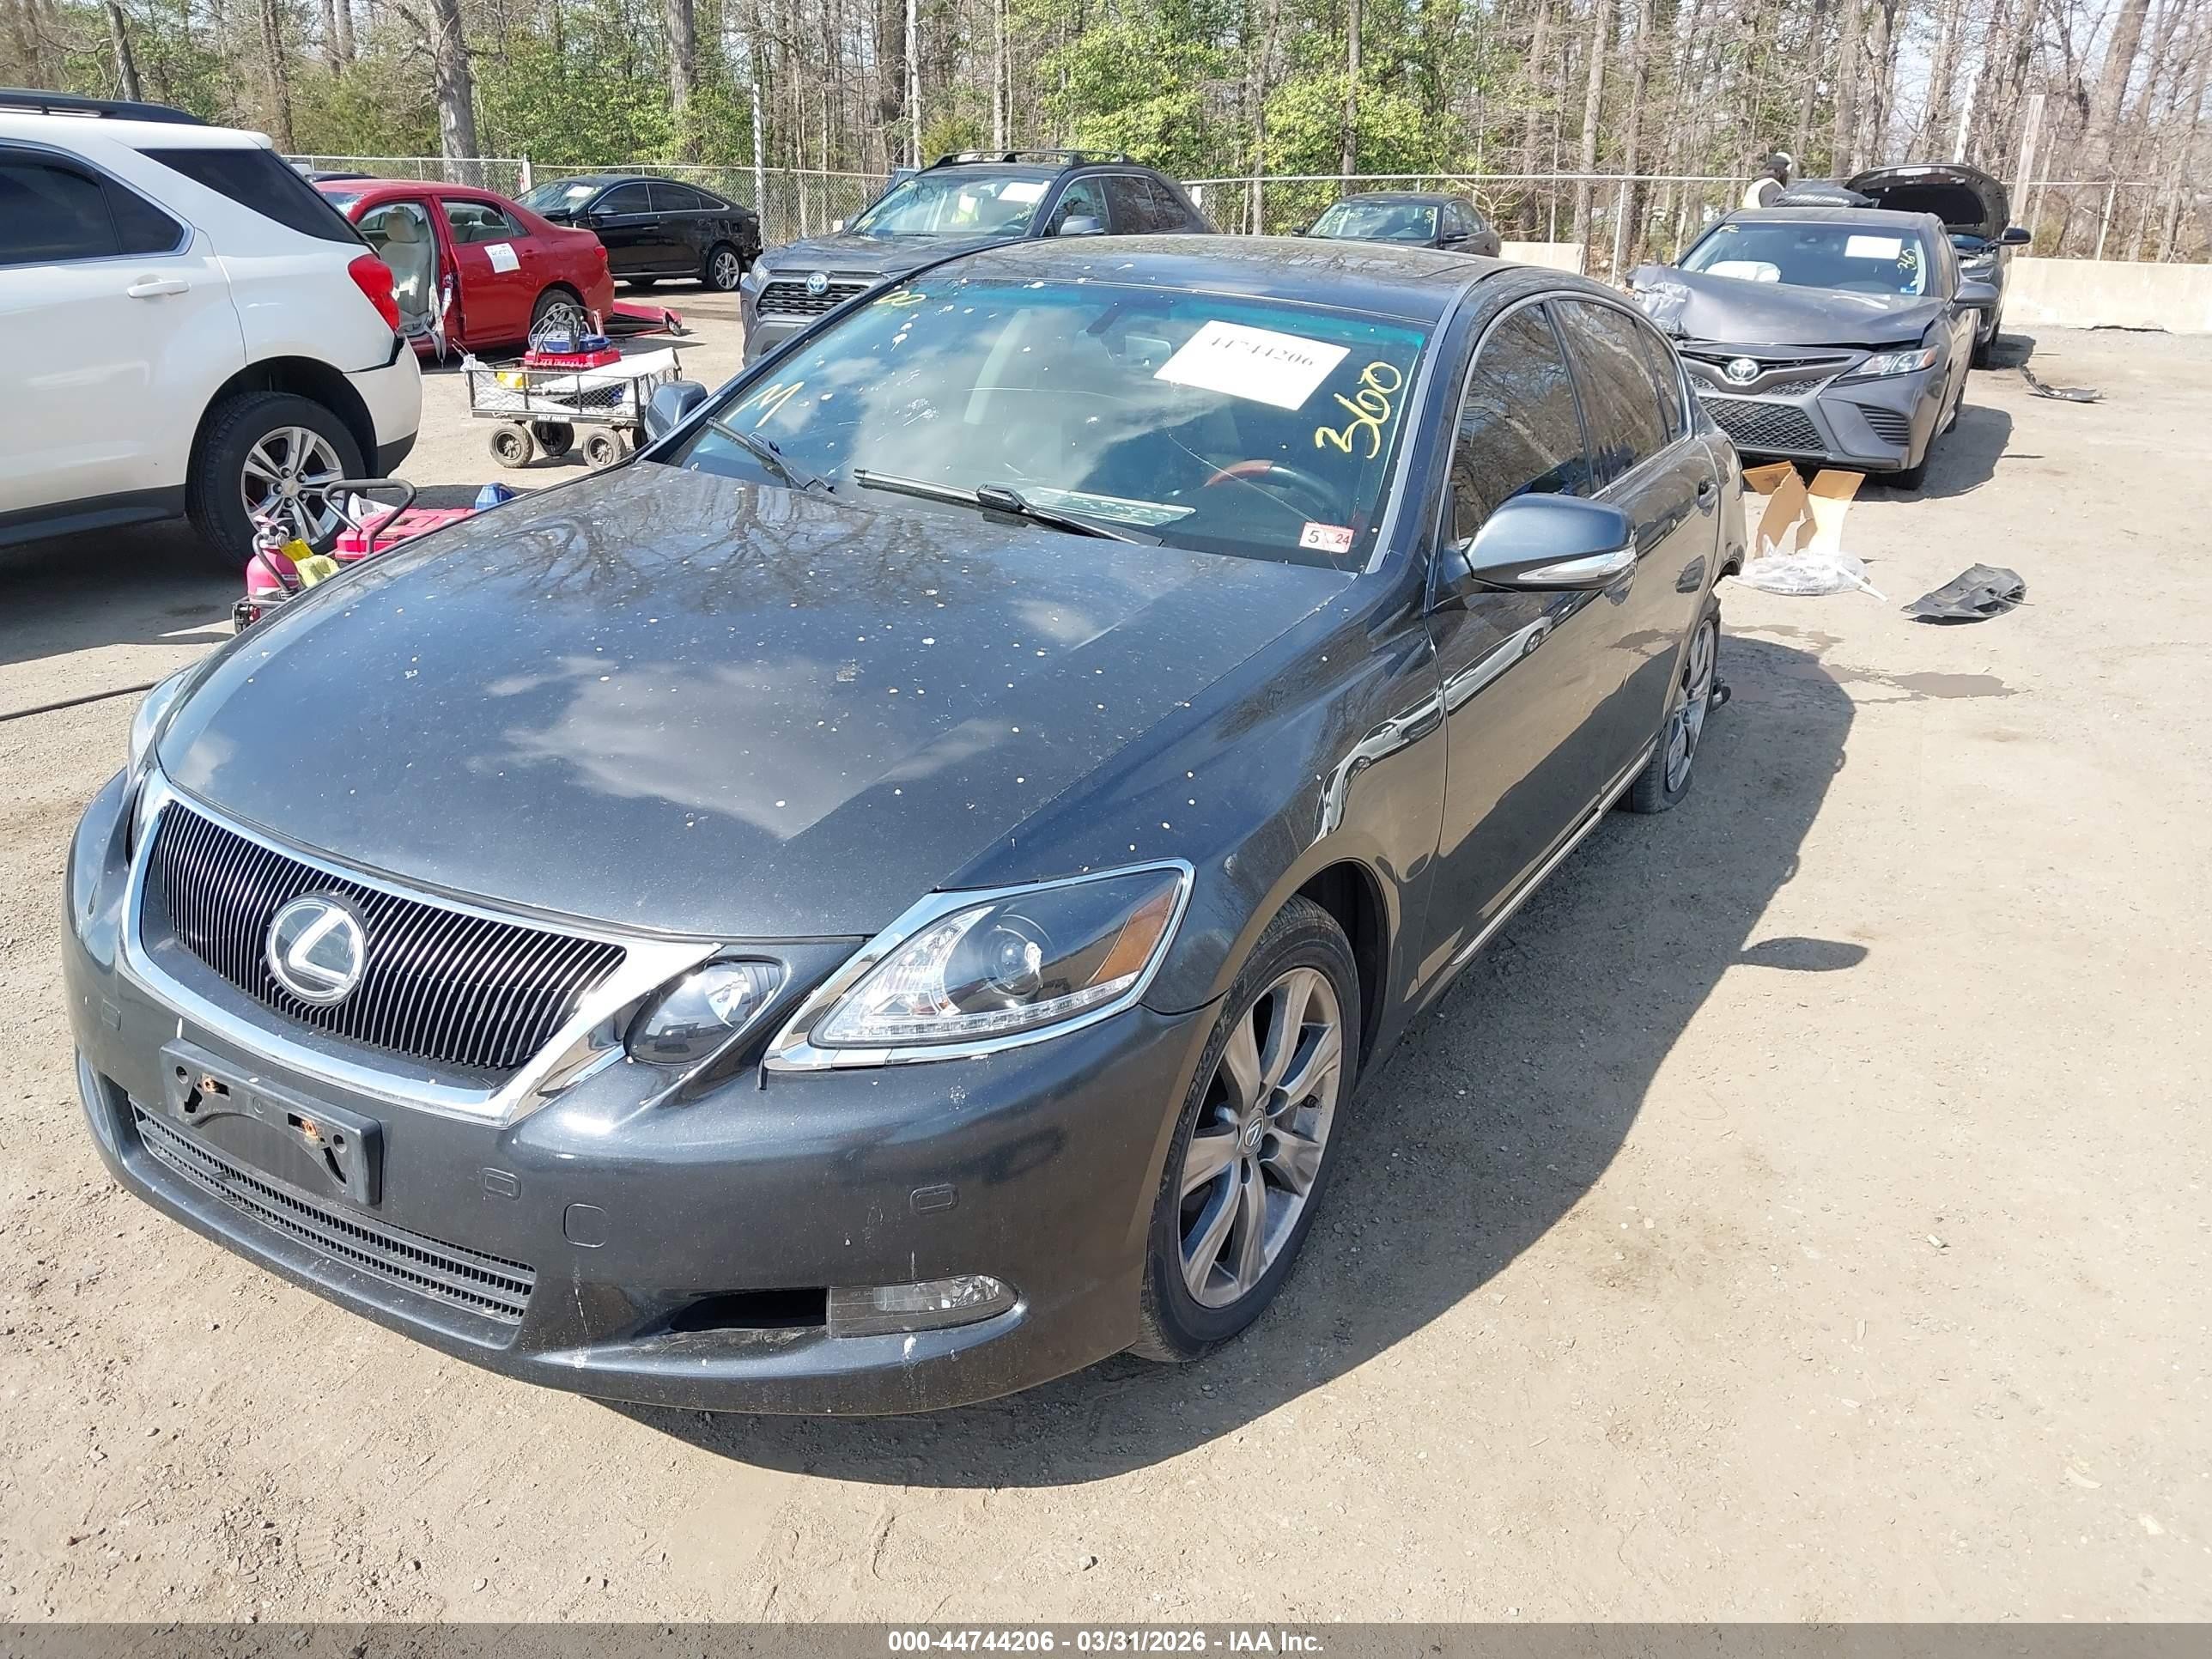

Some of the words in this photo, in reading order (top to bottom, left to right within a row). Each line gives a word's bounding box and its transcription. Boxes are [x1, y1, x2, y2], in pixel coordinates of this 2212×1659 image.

[1314, 361, 1402, 459] 360
[1308, 530, 1320, 544] 5
[1335, 533, 1350, 546] 24
